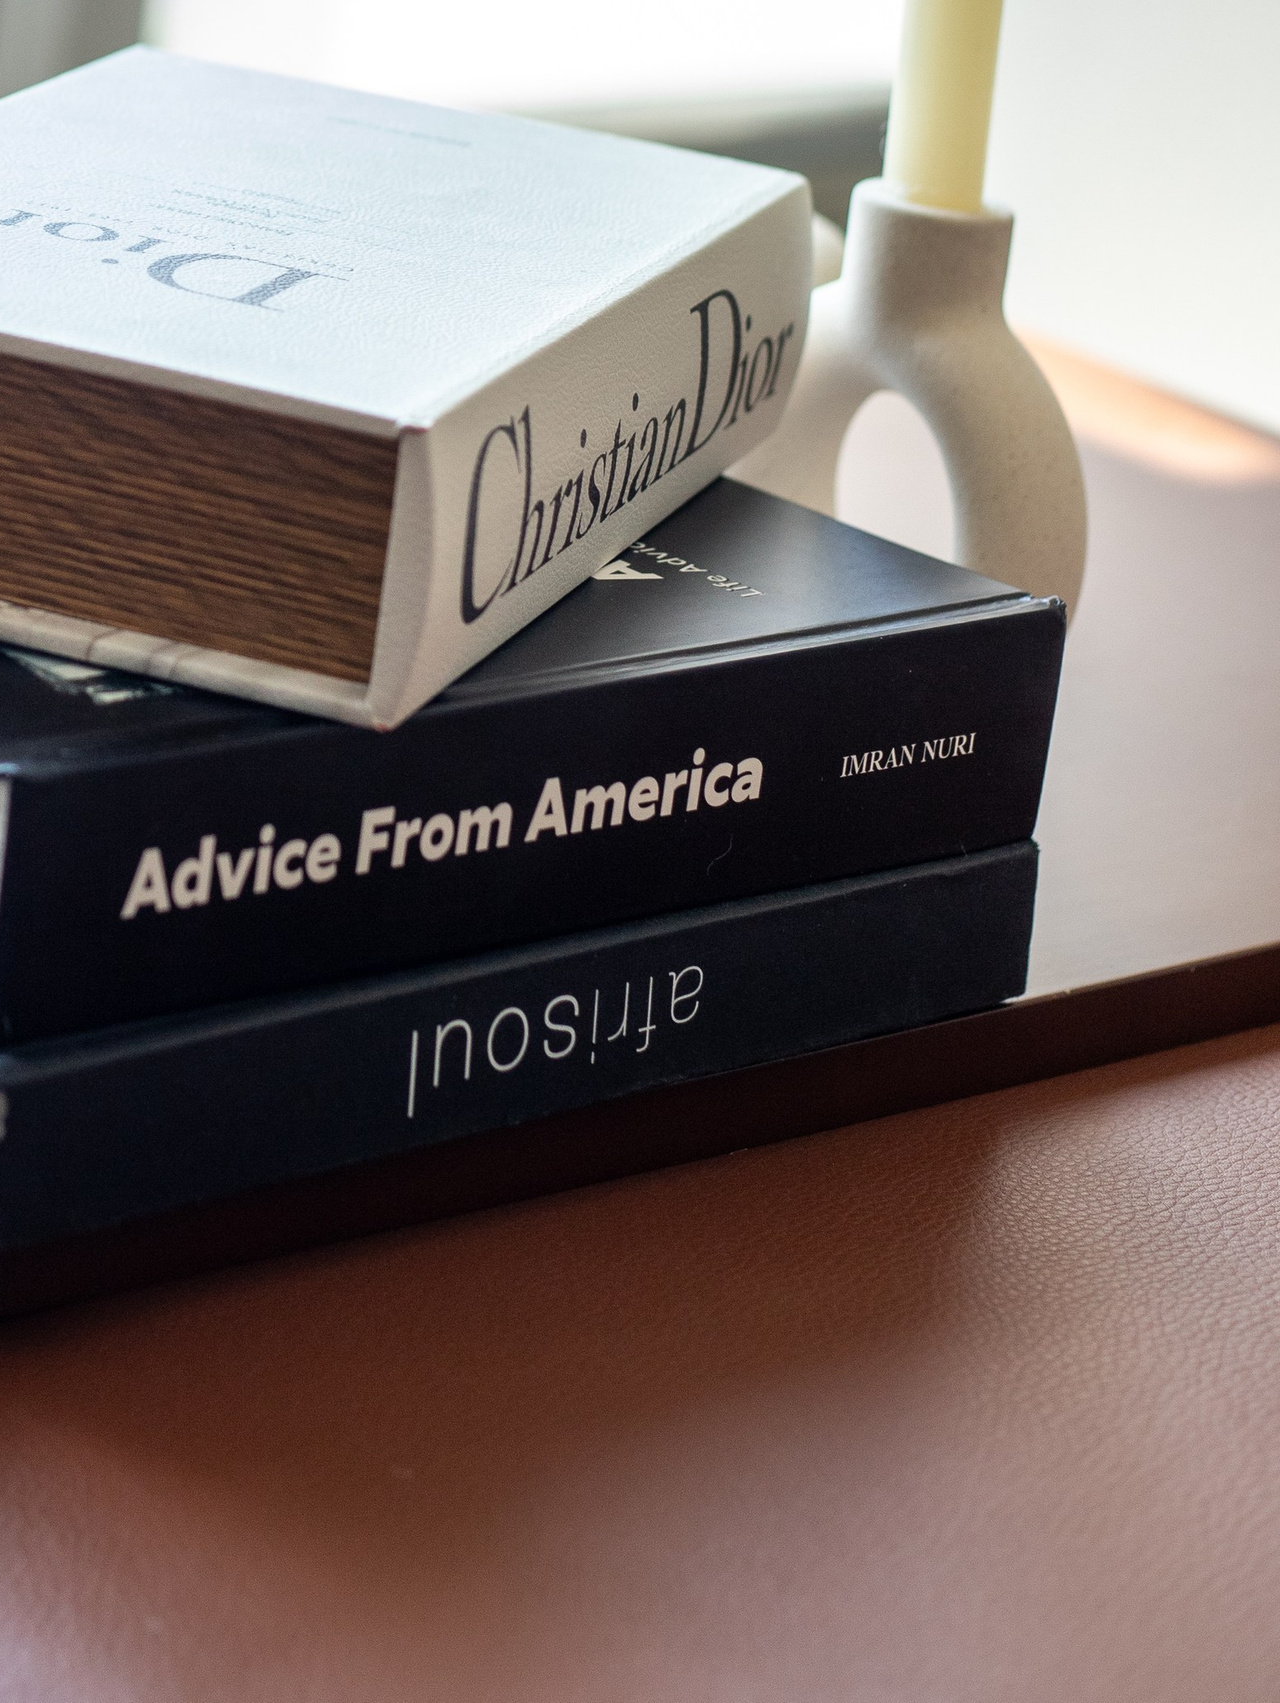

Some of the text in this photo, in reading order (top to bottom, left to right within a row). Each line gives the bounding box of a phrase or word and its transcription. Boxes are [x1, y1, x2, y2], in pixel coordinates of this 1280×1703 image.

[630, 541, 709, 573] Advic
[706, 574, 764, 597] Life
[839, 732, 977, 778] IMRAN NURI
[120, 747, 764, 919] Advice From America
[407, 965, 705, 1119] afrisoul
